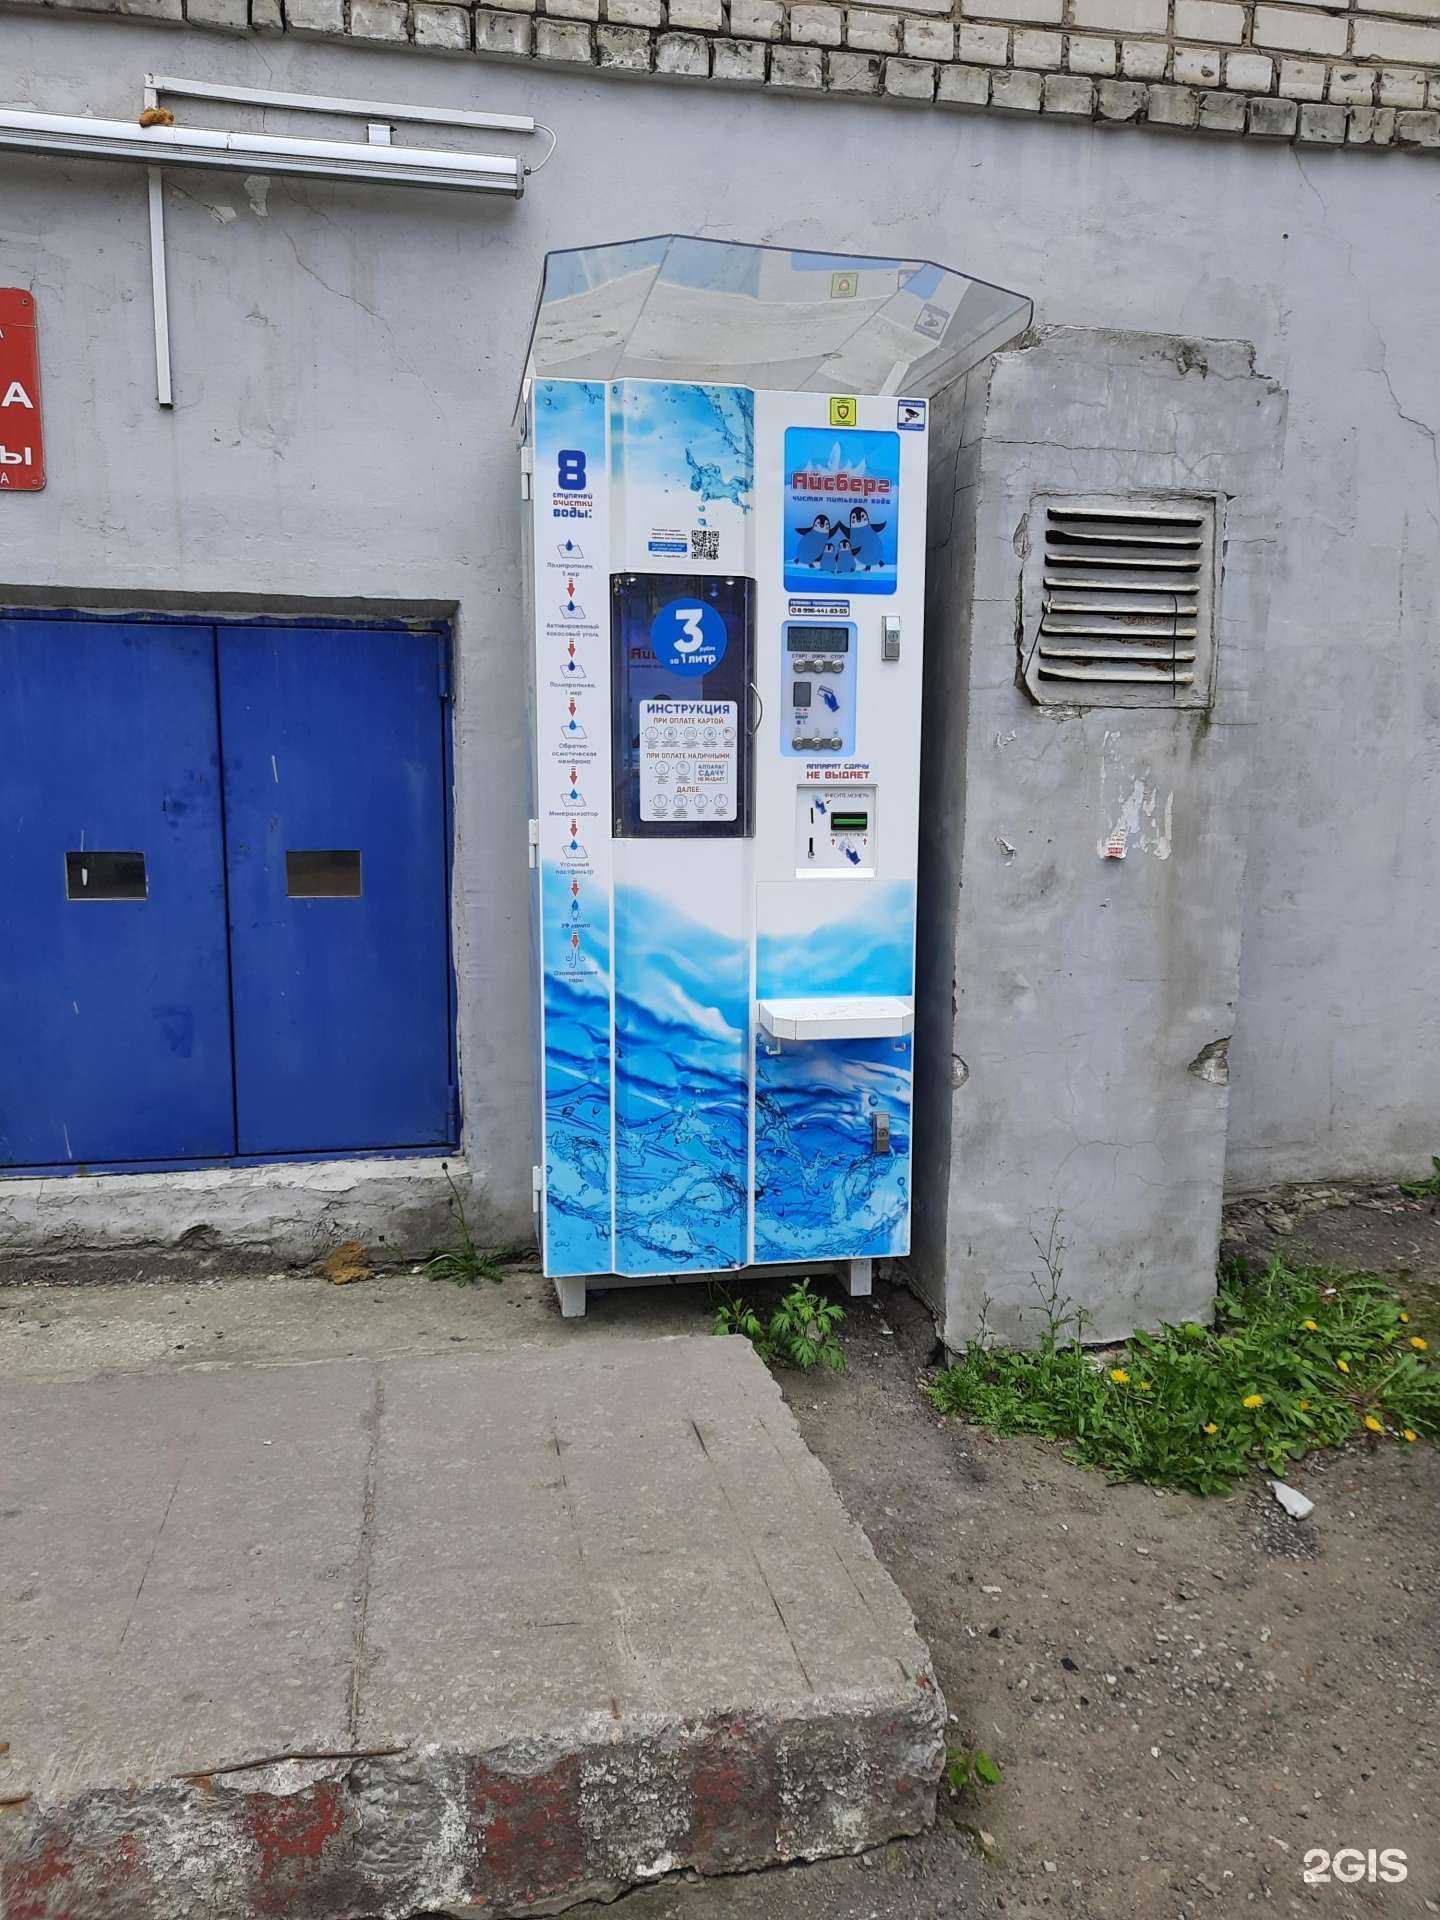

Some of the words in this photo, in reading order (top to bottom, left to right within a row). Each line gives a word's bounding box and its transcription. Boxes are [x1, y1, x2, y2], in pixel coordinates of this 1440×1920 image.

[558, 450, 587, 490] 8
[792, 472, 890, 496] Айсберг
[553, 507, 593, 518] воды:
[673, 608, 704, 653] 3
[680, 653, 686, 663] 1
[688, 655, 717, 664] литр
[647, 704, 730, 715] ИНСТРУКЦИЯ
[697, 716, 724, 725] КАРТОЙ
[806, 771, 821, 779] НЕ
[824, 771, 871, 779] ВЫДАЕТ
